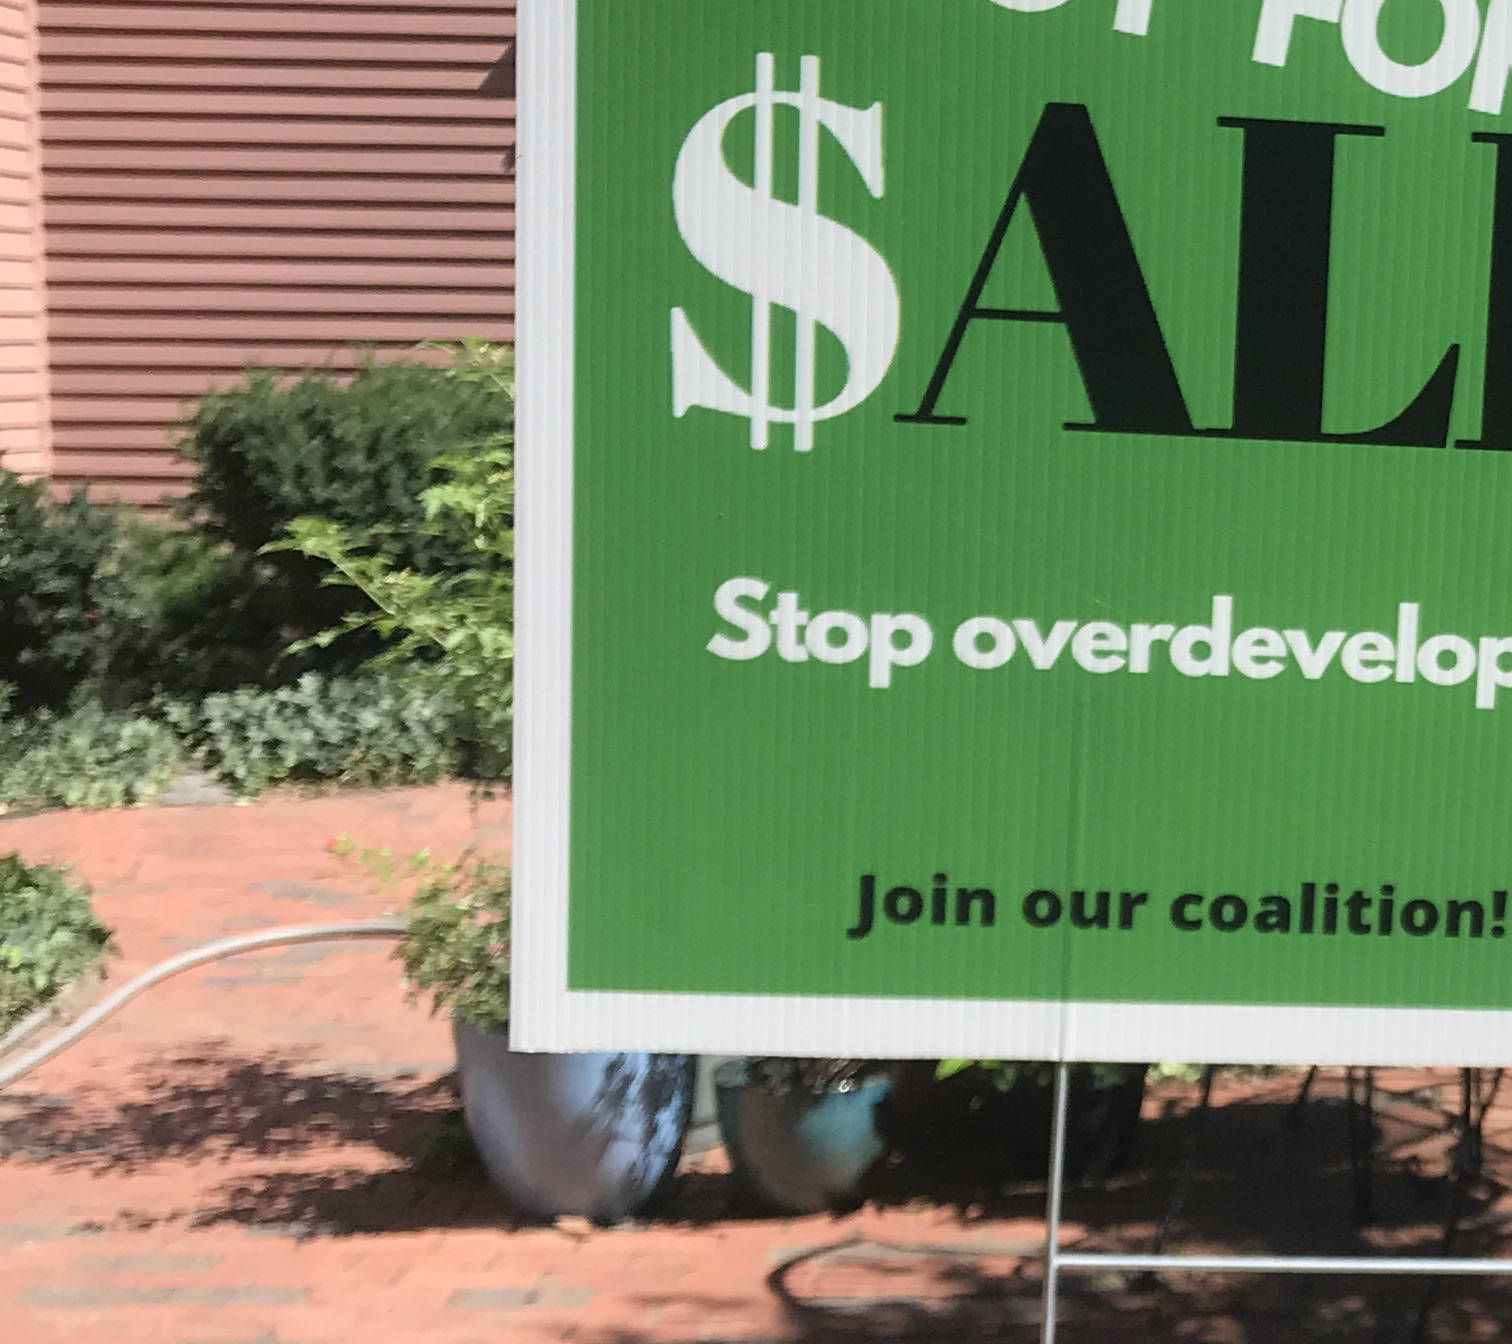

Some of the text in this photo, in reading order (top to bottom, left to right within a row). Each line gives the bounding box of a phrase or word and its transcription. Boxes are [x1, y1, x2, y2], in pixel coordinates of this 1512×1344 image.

[706, 577, 933, 689] Stop
[847, 872, 1509, 940] Join our coalition!
